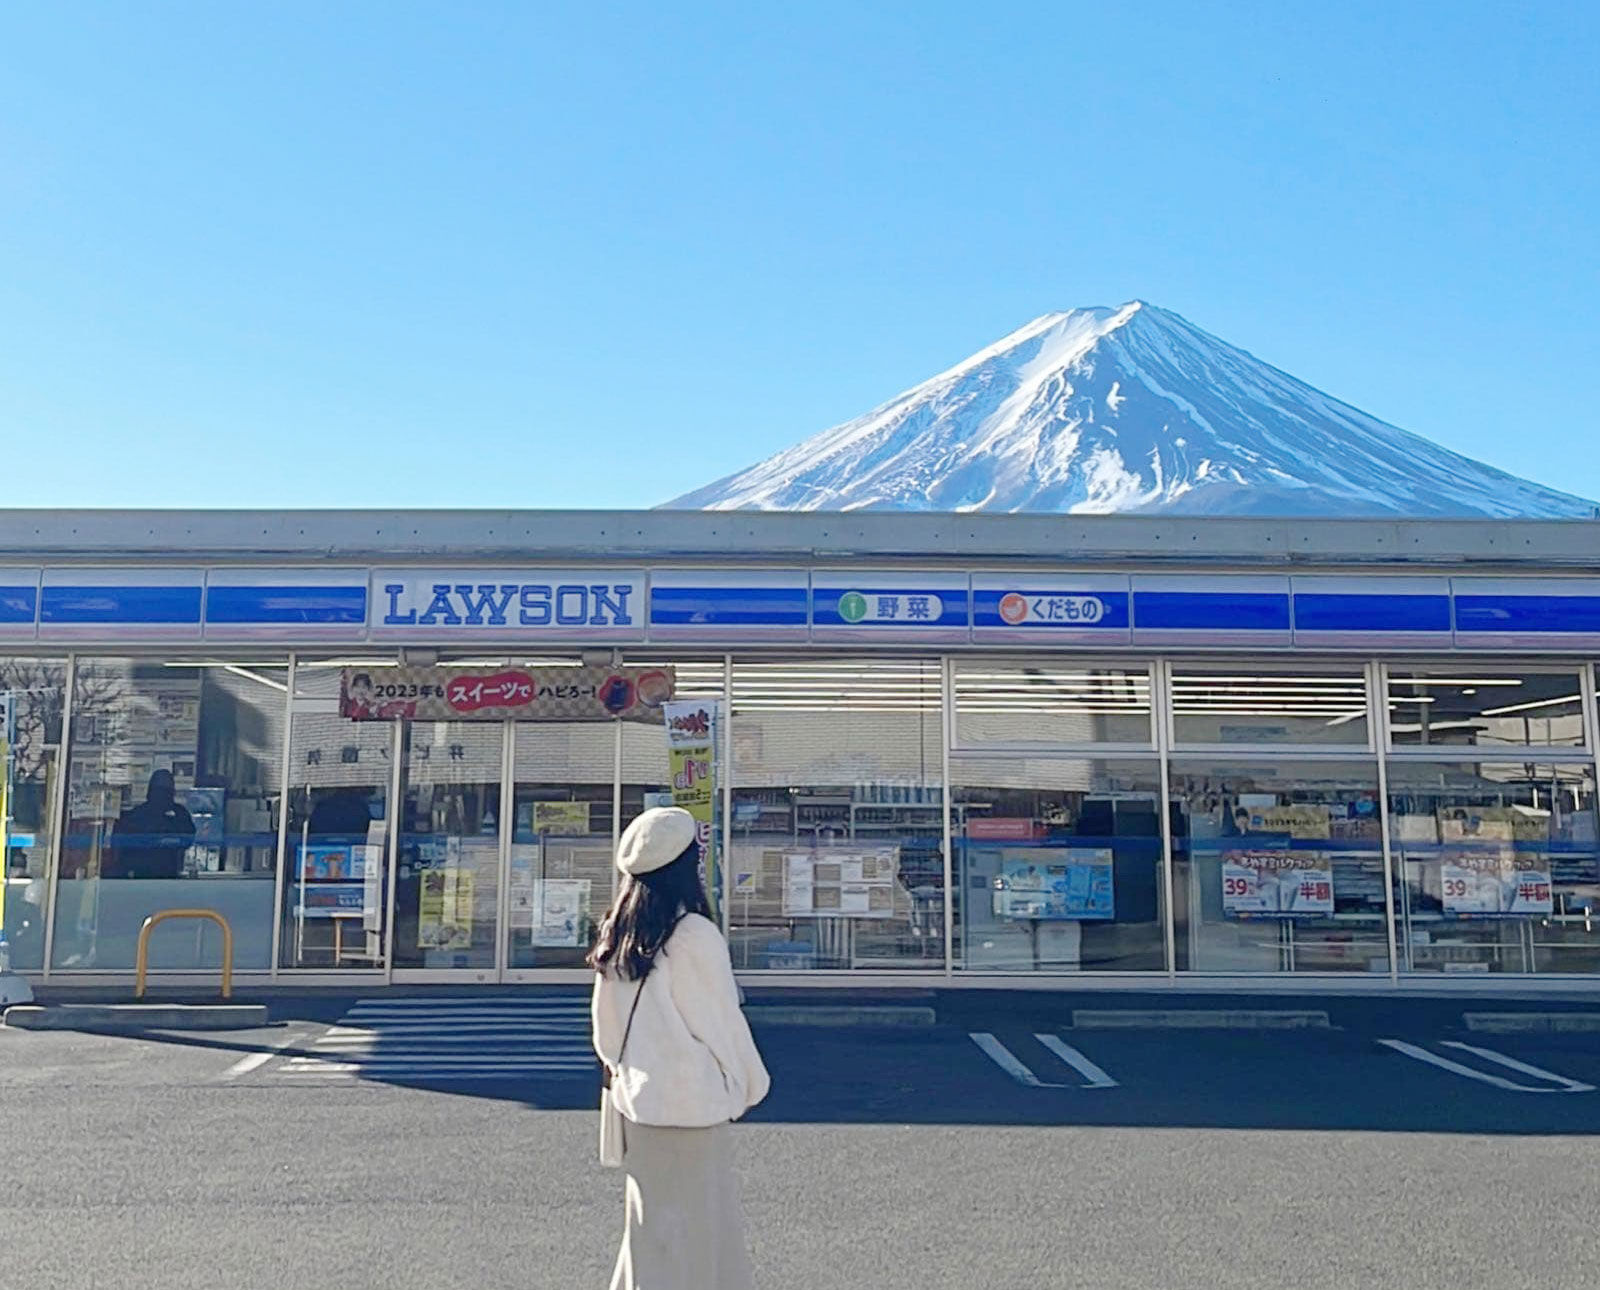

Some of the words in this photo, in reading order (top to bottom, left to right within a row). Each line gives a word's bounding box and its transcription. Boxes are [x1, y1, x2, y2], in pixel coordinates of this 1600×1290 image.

[384, 585, 632, 624] LAWSON
[877, 596, 929, 619] 野菜
[1031, 599, 1098, 620] くだもの
[375, 684, 444, 698] 2023年も
[451, 682, 531, 703] スイーツで
[1224, 878, 1248, 895] 39
[1444, 879, 1466, 896] 39
